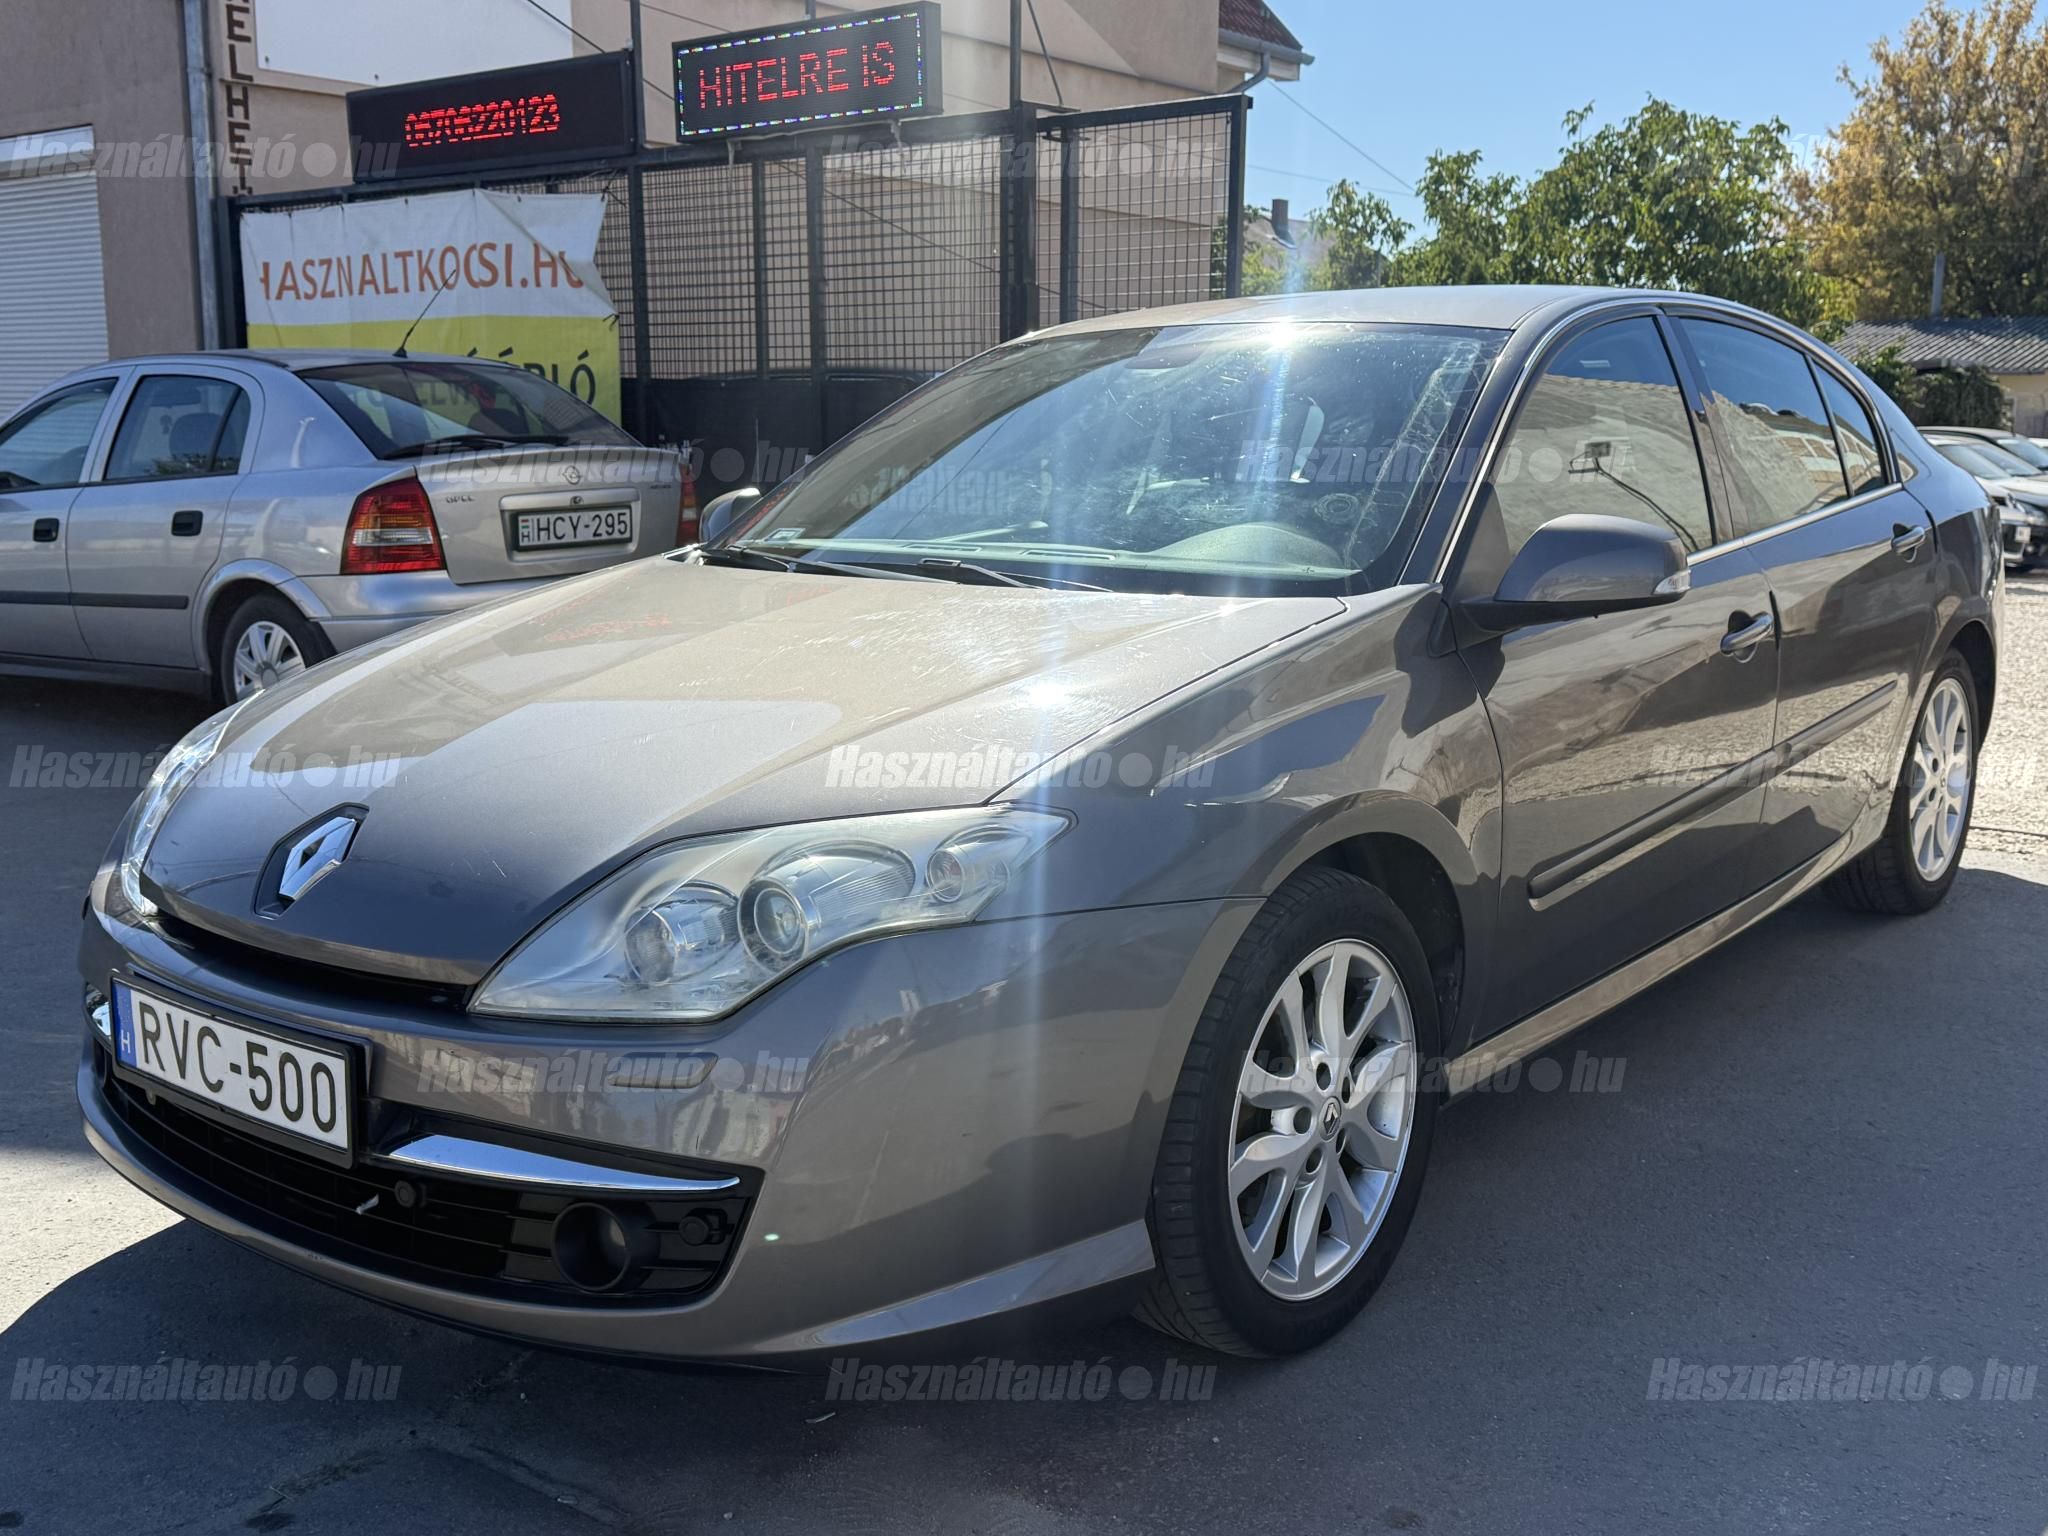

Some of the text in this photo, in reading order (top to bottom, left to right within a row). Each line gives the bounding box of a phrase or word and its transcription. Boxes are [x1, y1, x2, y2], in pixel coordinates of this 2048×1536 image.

[699, 41, 896, 109] HITELRE IS
[537, 512, 628, 541] HCY-295
[120, 1000, 337, 1134] H RVC-500
